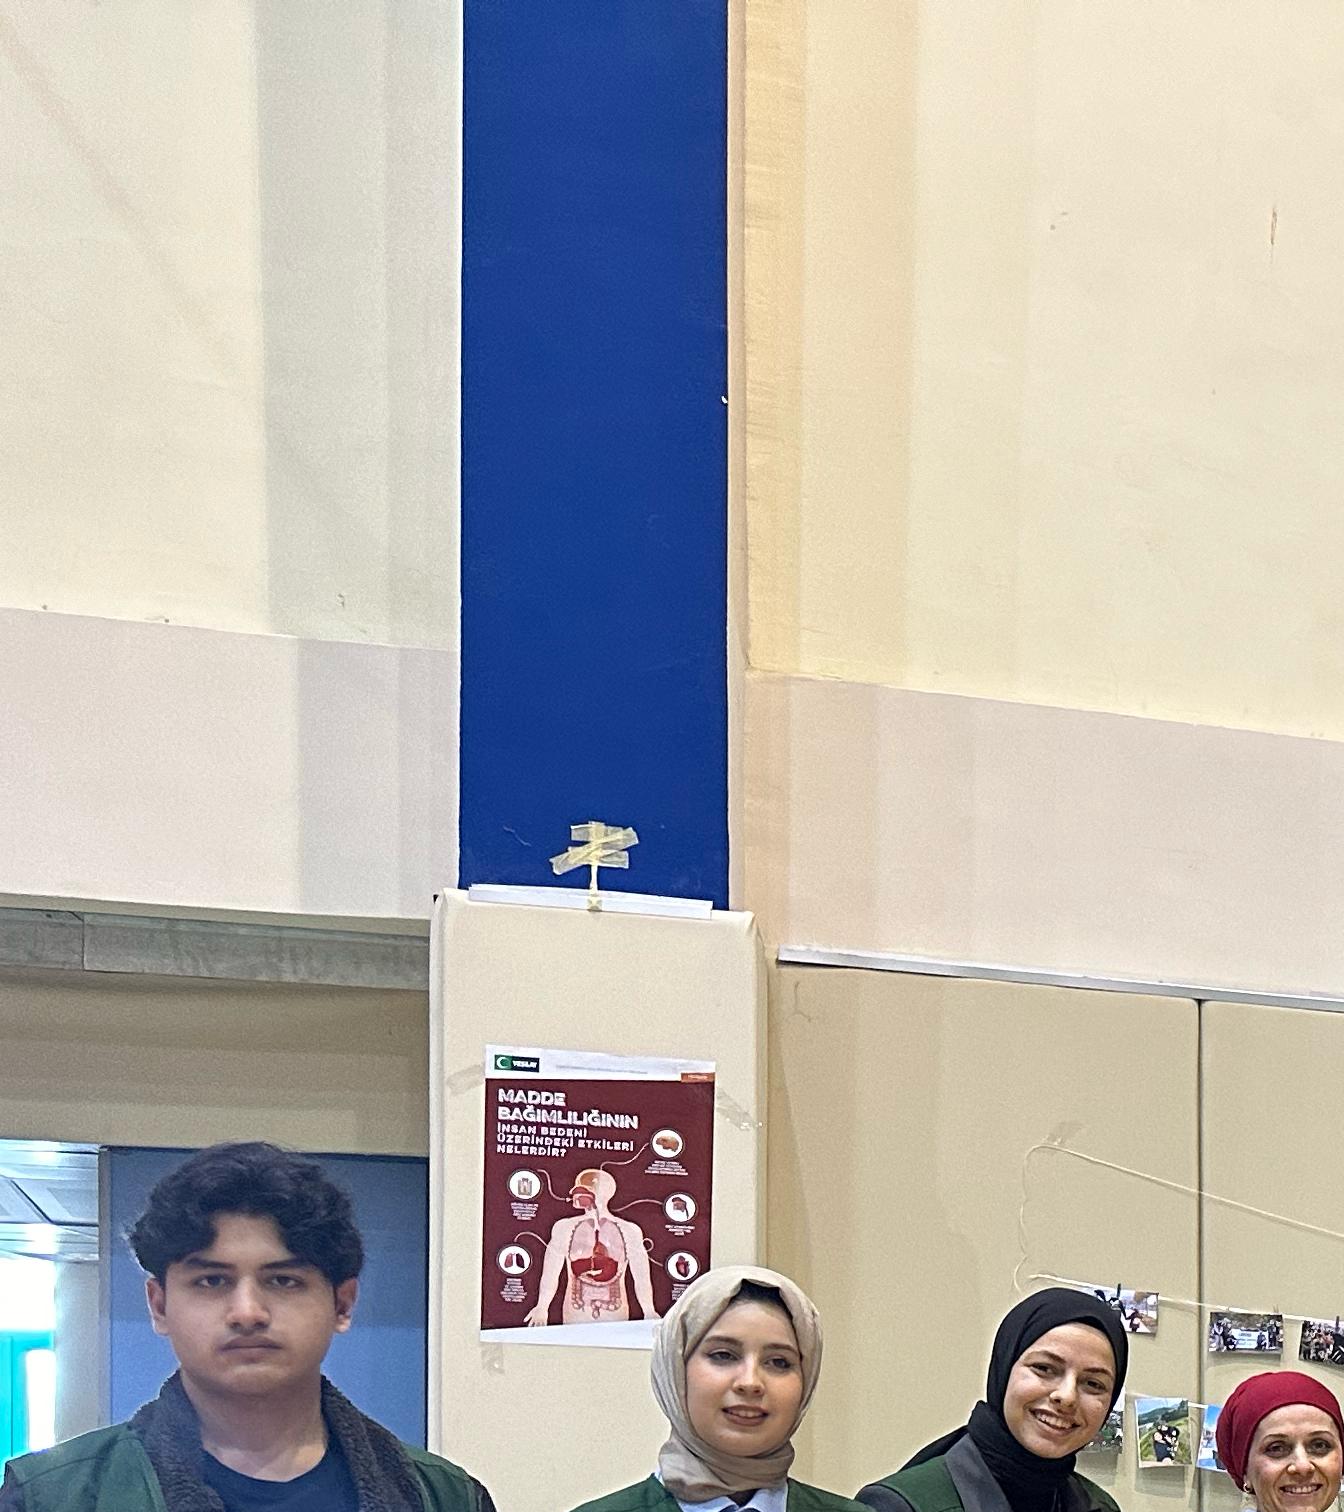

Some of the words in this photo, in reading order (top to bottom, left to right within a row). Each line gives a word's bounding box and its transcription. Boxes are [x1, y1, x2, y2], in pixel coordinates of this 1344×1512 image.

[498, 1088, 566, 1107] MADDE
[497, 1105, 639, 1129] BAĞIMLILIĞININ
[497, 1122, 537, 1135] İNSAN
[541, 1126, 588, 1138] BEDENİ
[497, 1132, 574, 1148] ÜZERİNDEKİ
[578, 1139, 634, 1152] ETKİLERİ
[497, 1144, 567, 1158] NELERDİR?
